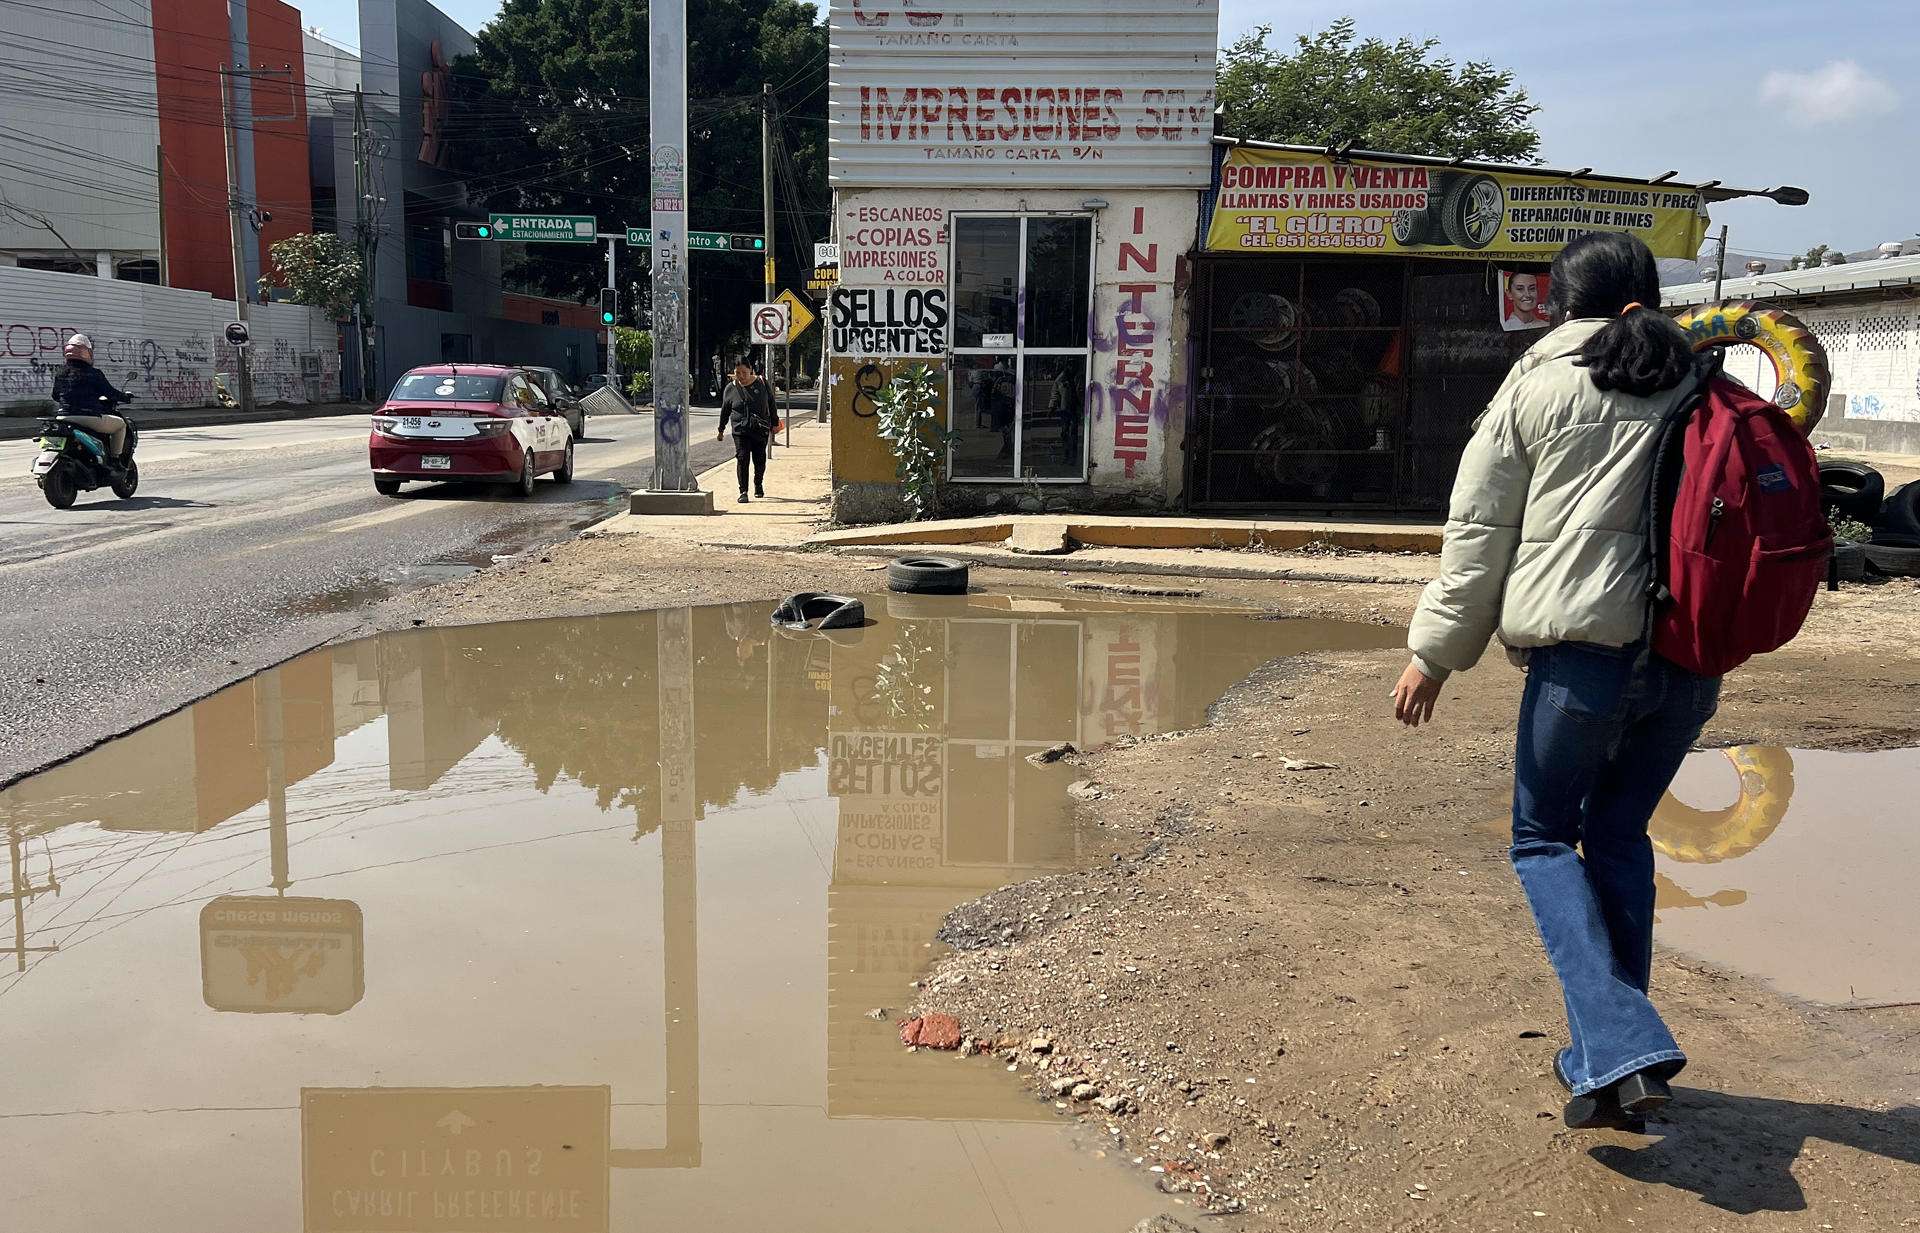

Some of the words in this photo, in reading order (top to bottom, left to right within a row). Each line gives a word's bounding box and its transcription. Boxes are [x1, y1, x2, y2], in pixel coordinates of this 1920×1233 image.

[860, 86, 1123, 142] IMPRESIONES
[923, 146, 994, 160] TAMAÑO
[1006, 149, 1060, 161] CARTA
[1073, 147, 1103, 160] B/N
[1223, 167, 1326, 188] COMPRA
[1333, 167, 1349, 188] Y
[1352, 167, 1428, 189] VENTA
[1221, 193, 1289, 208] LLANTAS
[1292, 194, 1304, 208] Y
[1307, 194, 1355, 208] RINES
[1360, 194, 1425, 209] USADOS
[1510, 187, 1584, 202] DIFERENTES
[1586, 189, 1648, 206] MEDIDAS
[1652, 193, 1661, 207] Y
[859, 207, 943, 222] ESCANEOS
[1511, 207, 1590, 224] REPARACIÓN
[1594, 210, 1609, 224] DE
[1613, 212, 1653, 228] RINES
[512, 218, 573, 229] ENTRADA
[512, 231, 574, 239] ESTACIONAMIENTO
[688, 236, 711, 246] ntro
[857, 228, 932, 246] COPIAS
[1241, 235, 1273, 247] CEL.
[1276, 235, 1305, 247] 951
[1308, 235, 1341, 247] 354
[1344, 235, 1387, 247] 5507
[1510, 226, 1564, 243] SECCIÓN
[844, 250, 938, 268] IMPRESIONES
[884, 270, 895, 281] A
[898, 270, 945, 283] COLOR
[832, 288, 948, 328] SELLOS
[833, 328, 946, 354] URGENTES
[1113, 206, 1158, 480] INTERNET
